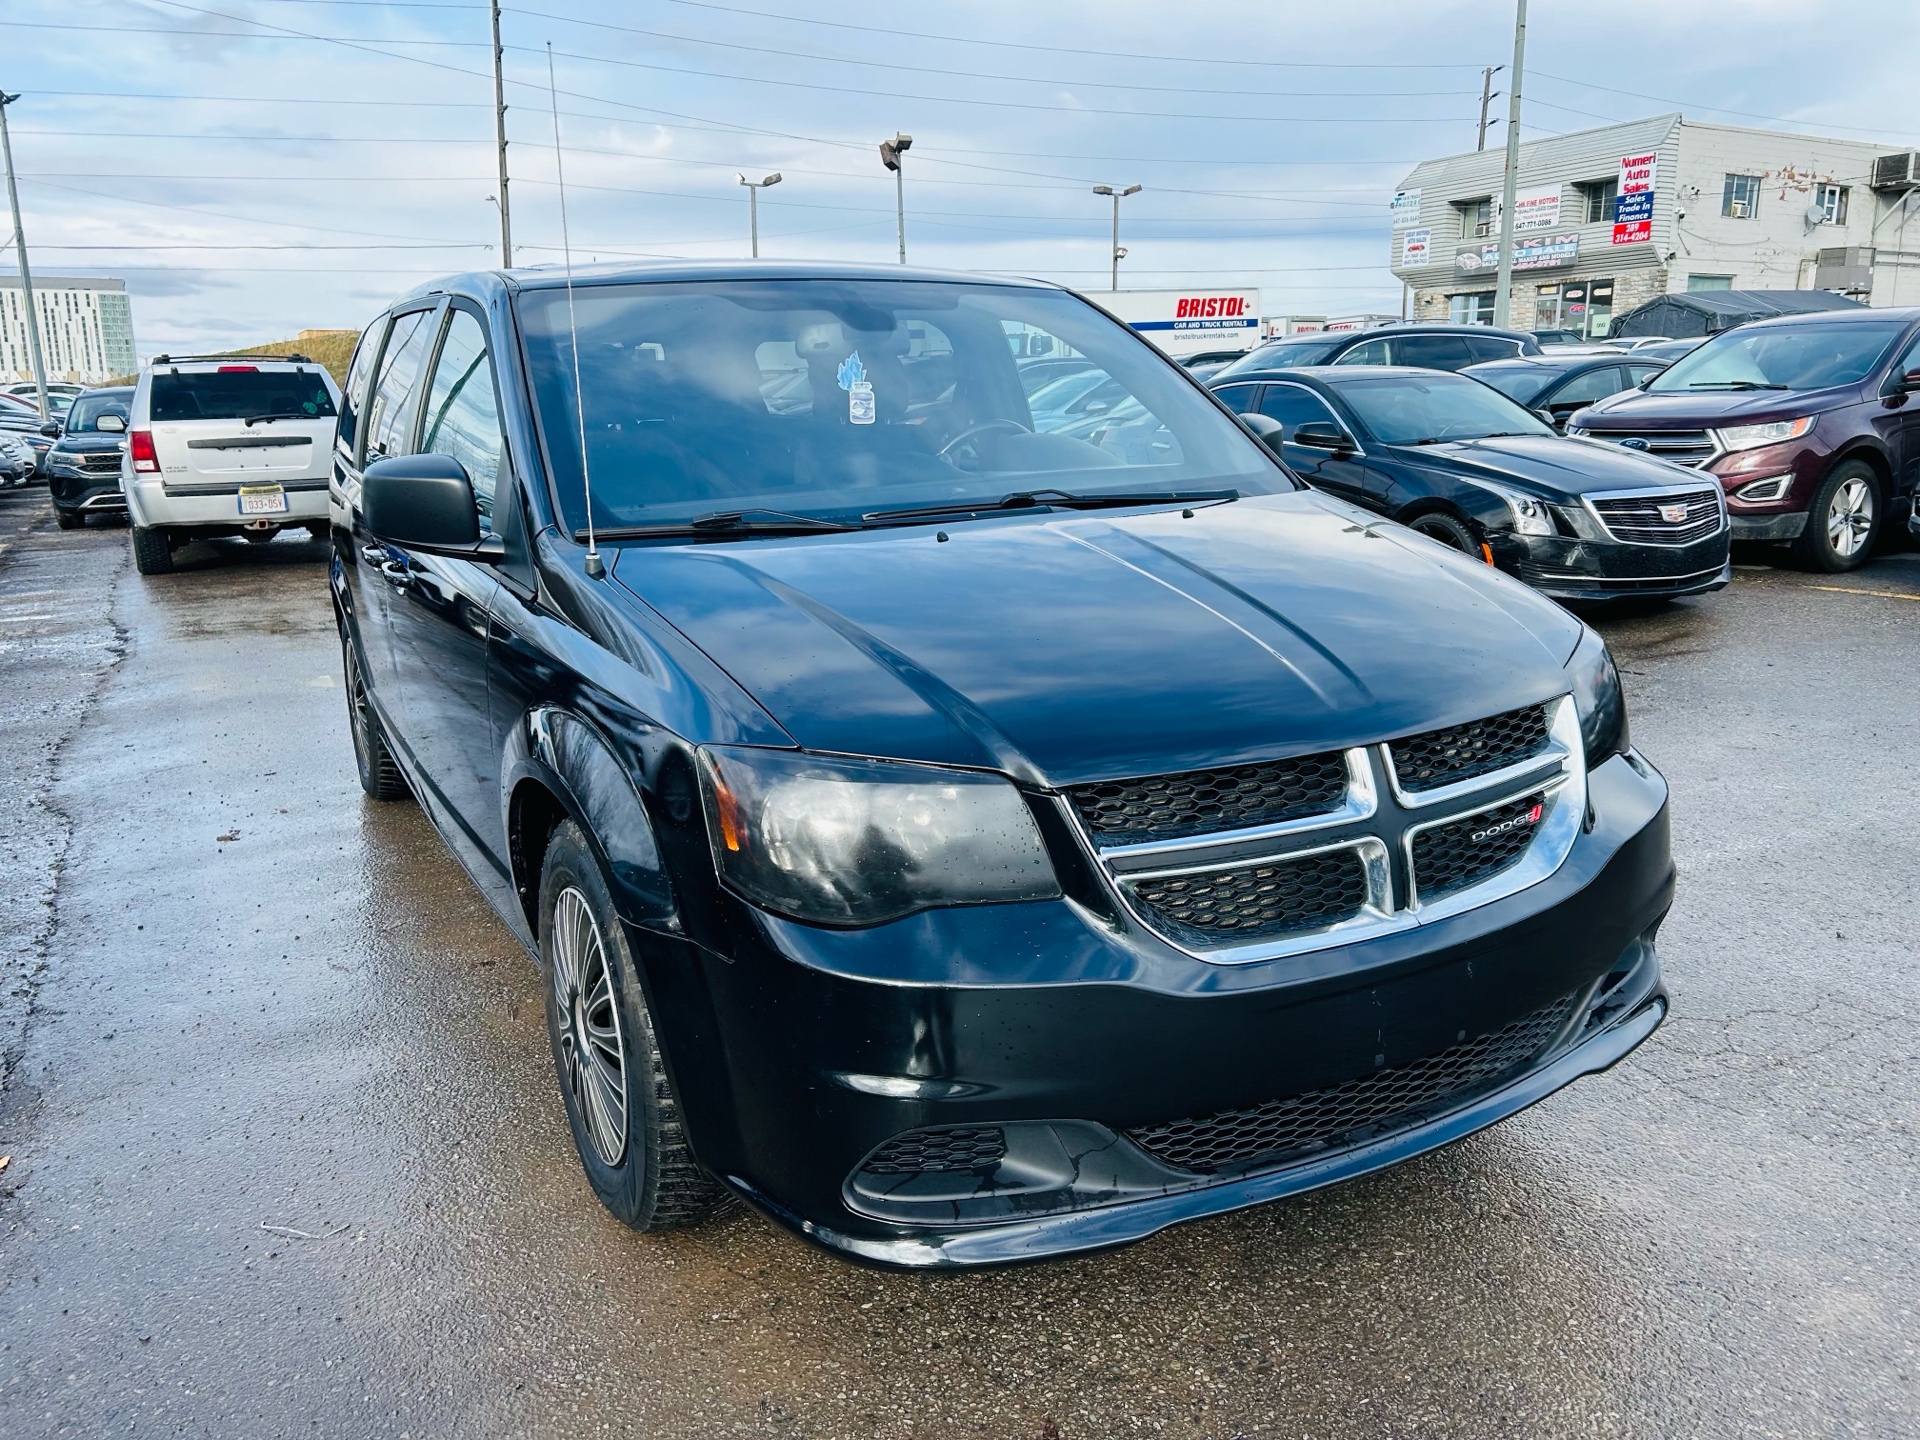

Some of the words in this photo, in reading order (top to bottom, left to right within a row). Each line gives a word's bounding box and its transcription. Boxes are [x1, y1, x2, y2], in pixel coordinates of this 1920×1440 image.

[1621, 152, 1657, 169] Numeri
[1625, 169, 1650, 181] Auto
[1623, 182, 1649, 195] Sales
[1527, 199, 1538, 207] FINE
[1538, 196, 1559, 206] MOTORS
[1624, 195, 1646, 204] Sales
[1618, 203, 1641, 213] Trade
[1618, 212, 1649, 223] Finance
[1625, 223, 1640, 233] 289
[1614, 230, 1649, 244] 314-4204
[1531, 243, 1577, 257] SALE
[1517, 255, 1538, 263] MAKES
[1551, 251, 1576, 259] MODELS
[1176, 297, 1244, 319] BRISTOL
[1188, 321, 1200, 329] AND
[1174, 332, 1239, 341] bristoltruckrentals.com
[240, 428, 262, 436] Jeep
[1472, 812, 1534, 842] DODGE
